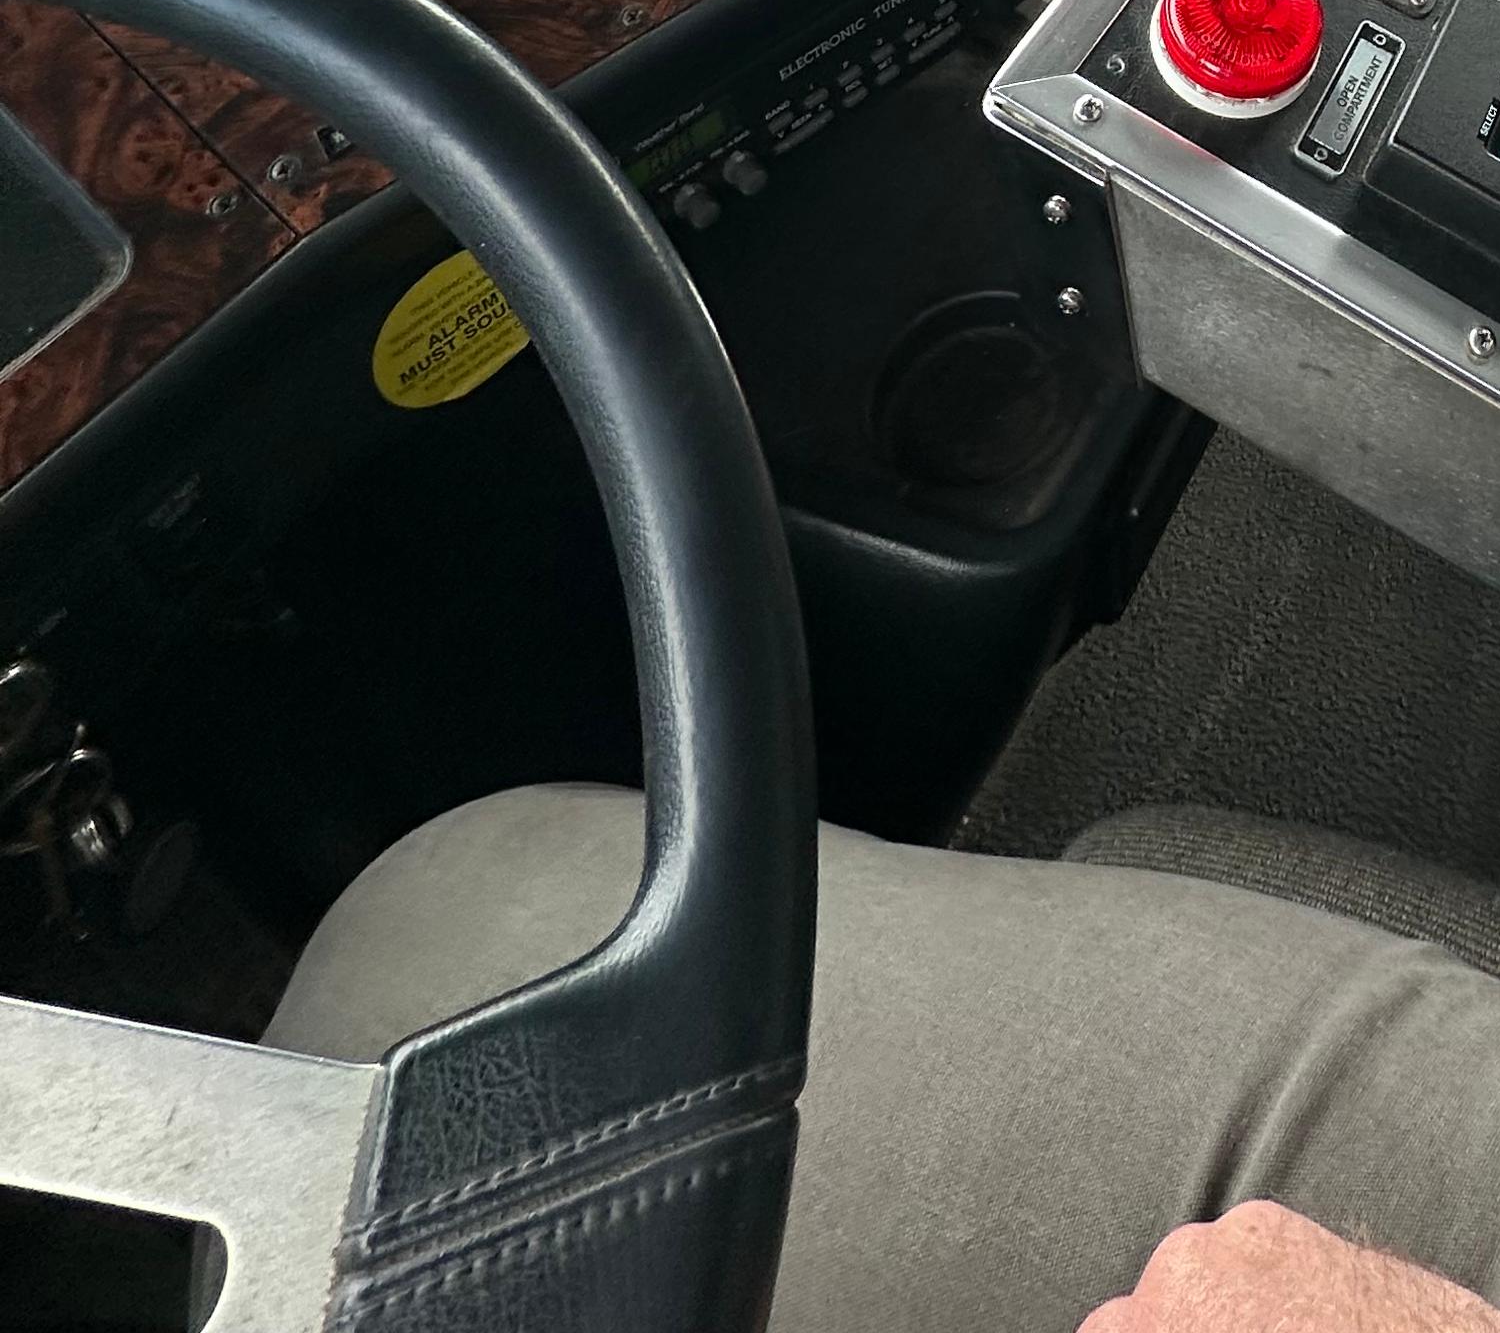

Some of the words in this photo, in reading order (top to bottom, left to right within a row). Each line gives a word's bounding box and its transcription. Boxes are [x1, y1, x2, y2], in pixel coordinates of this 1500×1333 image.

[778, 17, 868, 82] ELECTRONIC
[1332, 56, 1383, 141] COMPARTMENT
[1336, 74, 1360, 108] OPEN
[1479, 104, 1499, 137] SELECT
[428, 292, 500, 350] ALARM
[400, 337, 456, 384] MUST
